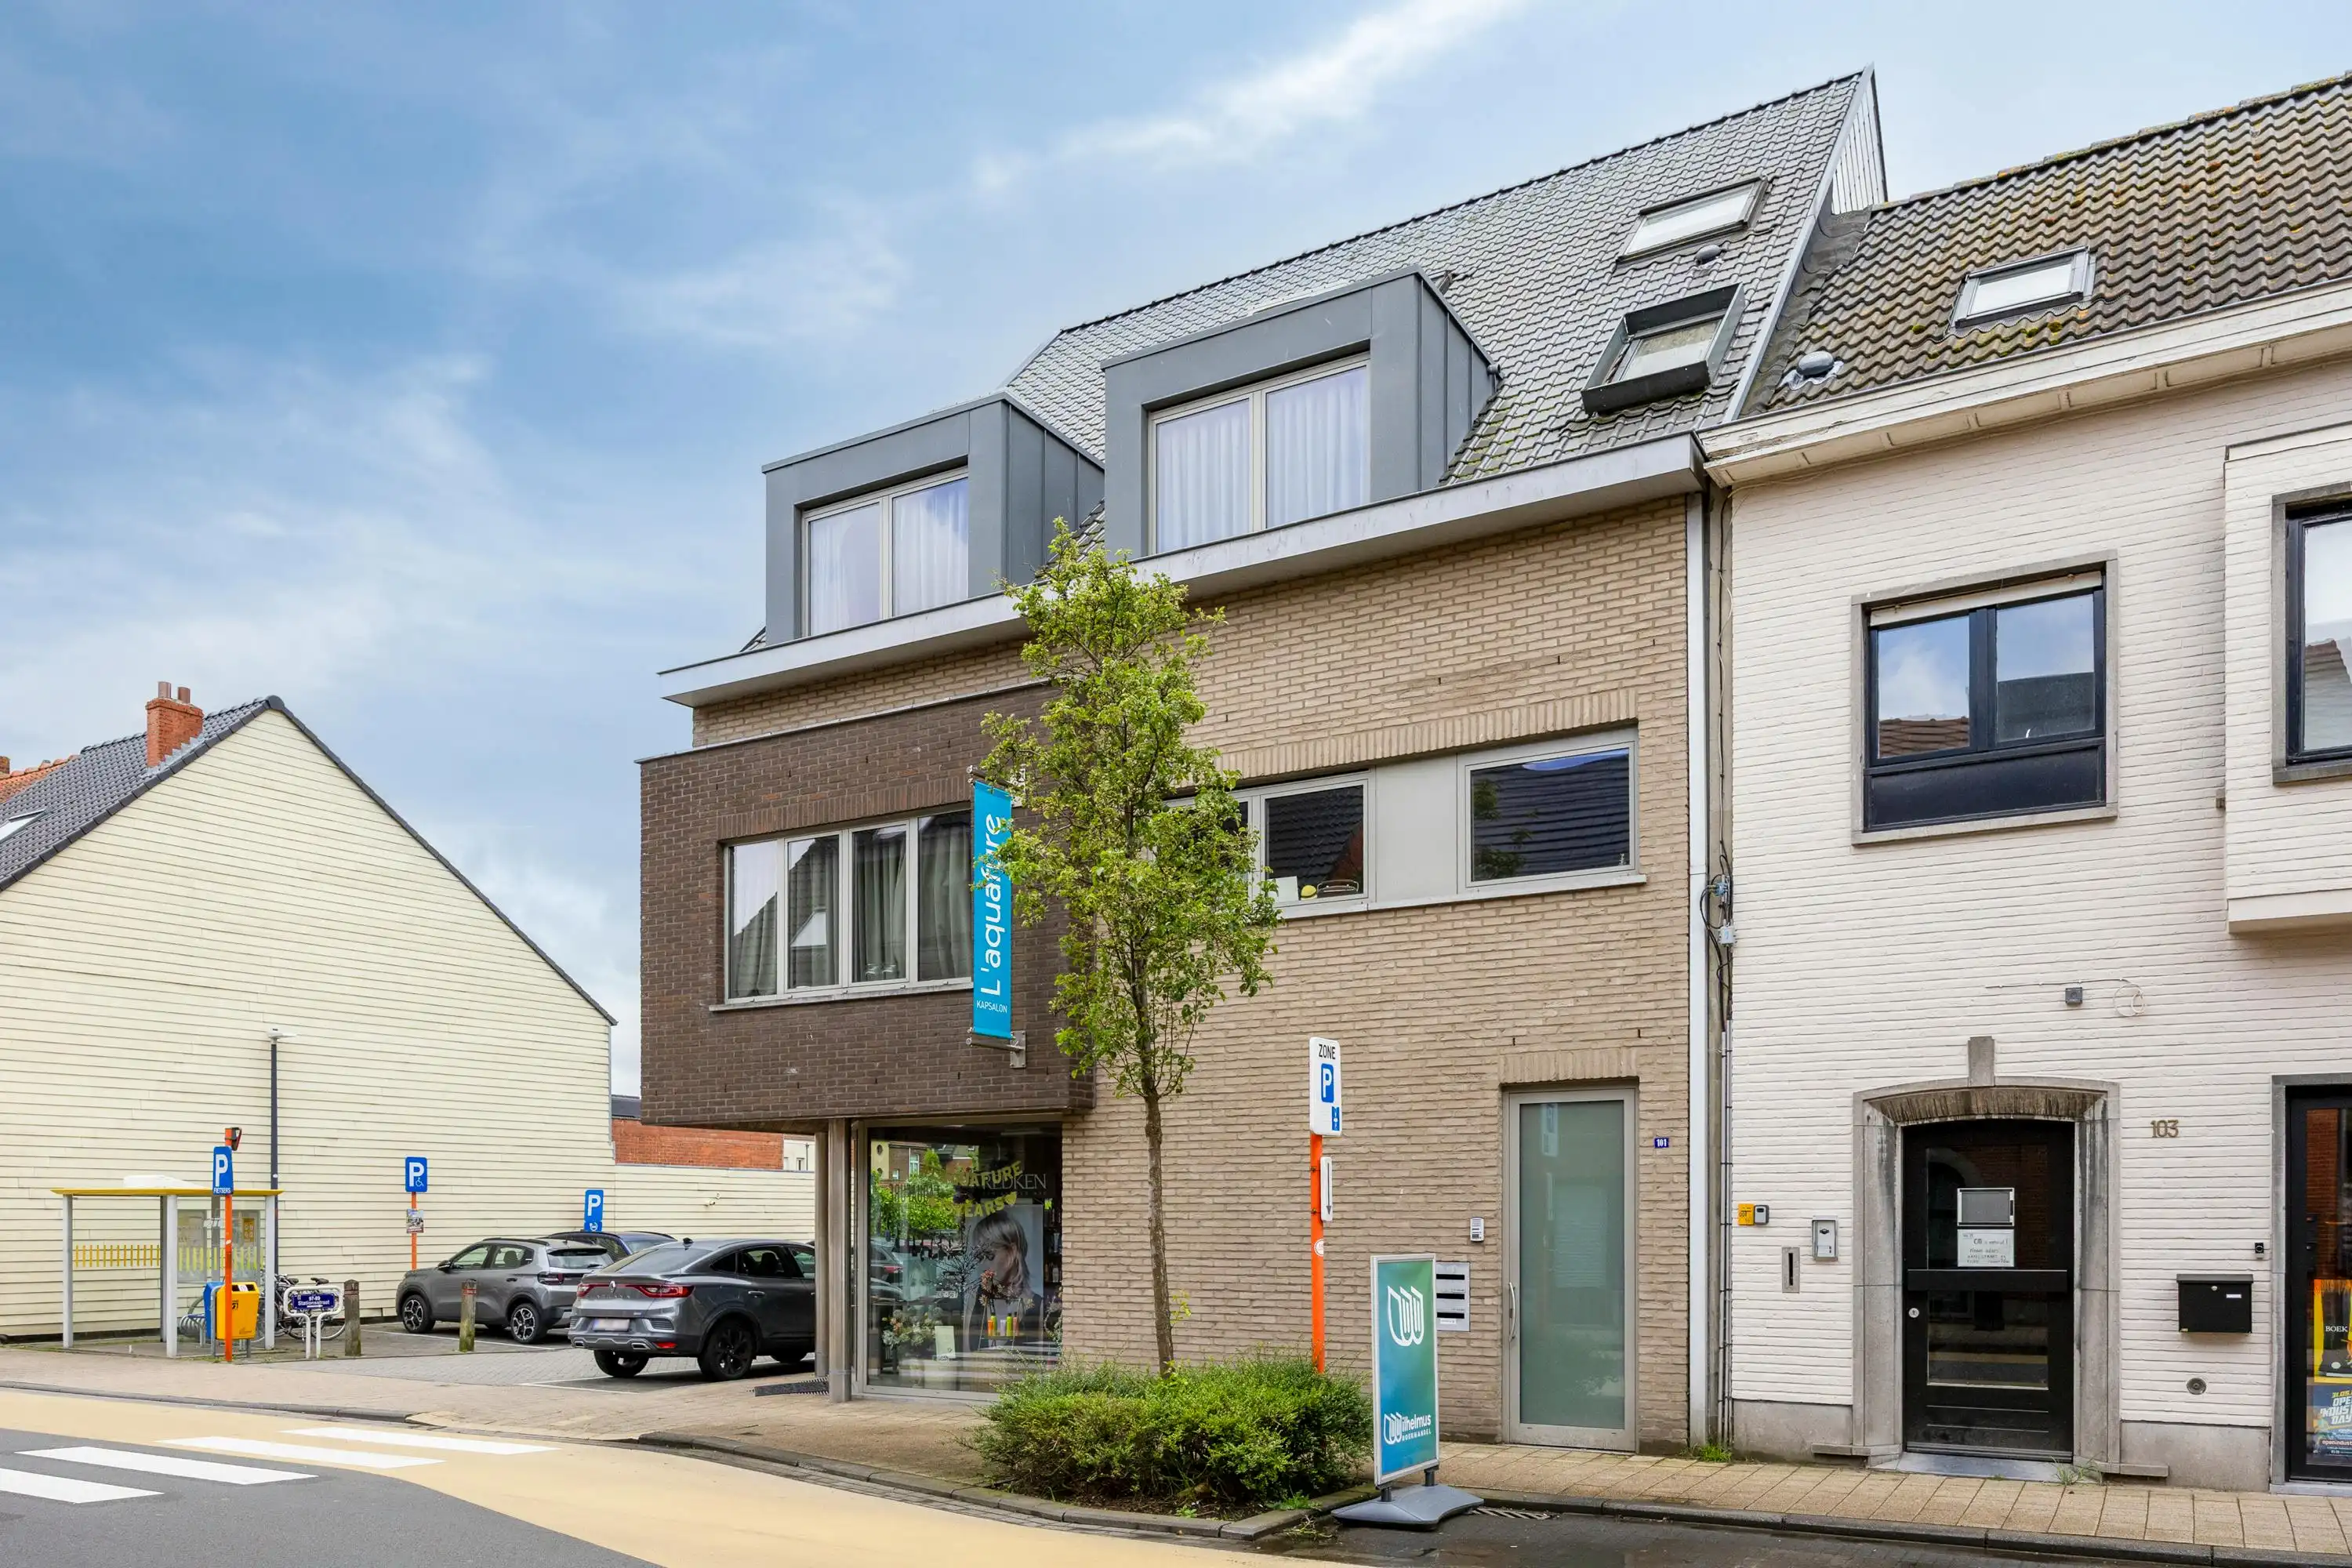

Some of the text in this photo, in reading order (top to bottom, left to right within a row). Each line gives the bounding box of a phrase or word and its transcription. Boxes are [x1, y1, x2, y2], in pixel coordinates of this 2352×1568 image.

[976, 1000, 1008, 1014] KAPSALON
[1318, 1044, 1336, 1060] ZONE
[1323, 1068, 1333, 1098] P
[2150, 1119, 2180, 1138] 103
[1656, 1138, 1668, 1147] 101
[215, 1153, 229, 1187] P
[408, 1162, 425, 1187] P
[587, 1194, 601, 1216] P
[2332, 1396, 2352, 1406] OPE
[2320, 1405, 2352, 1417] INDUS
[1384, 1411, 1432, 1445] Wilhelmus
